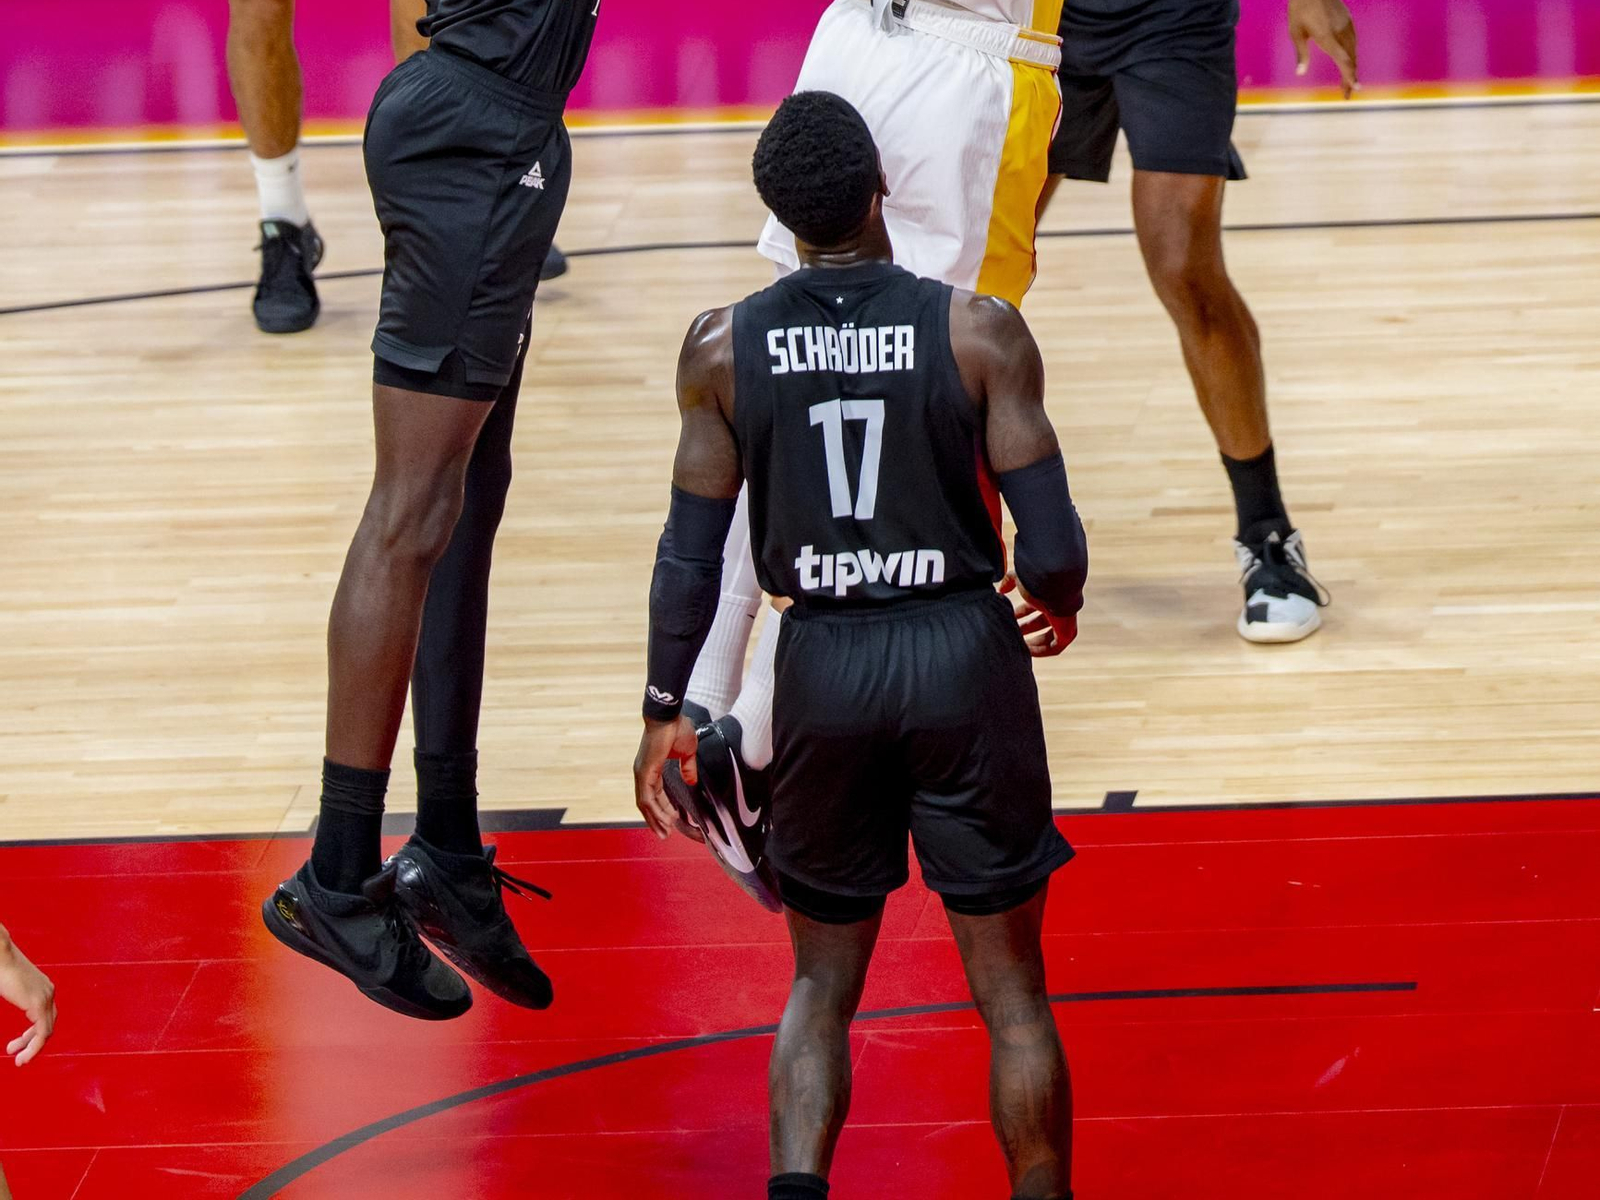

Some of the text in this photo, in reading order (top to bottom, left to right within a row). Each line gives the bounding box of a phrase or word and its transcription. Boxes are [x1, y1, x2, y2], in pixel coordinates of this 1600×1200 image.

[519, 174, 546, 190] PEAK
[767, 322, 914, 374] SCHRÖDER
[809, 398, 885, 520] 17
[795, 544, 945, 597] tipwin
